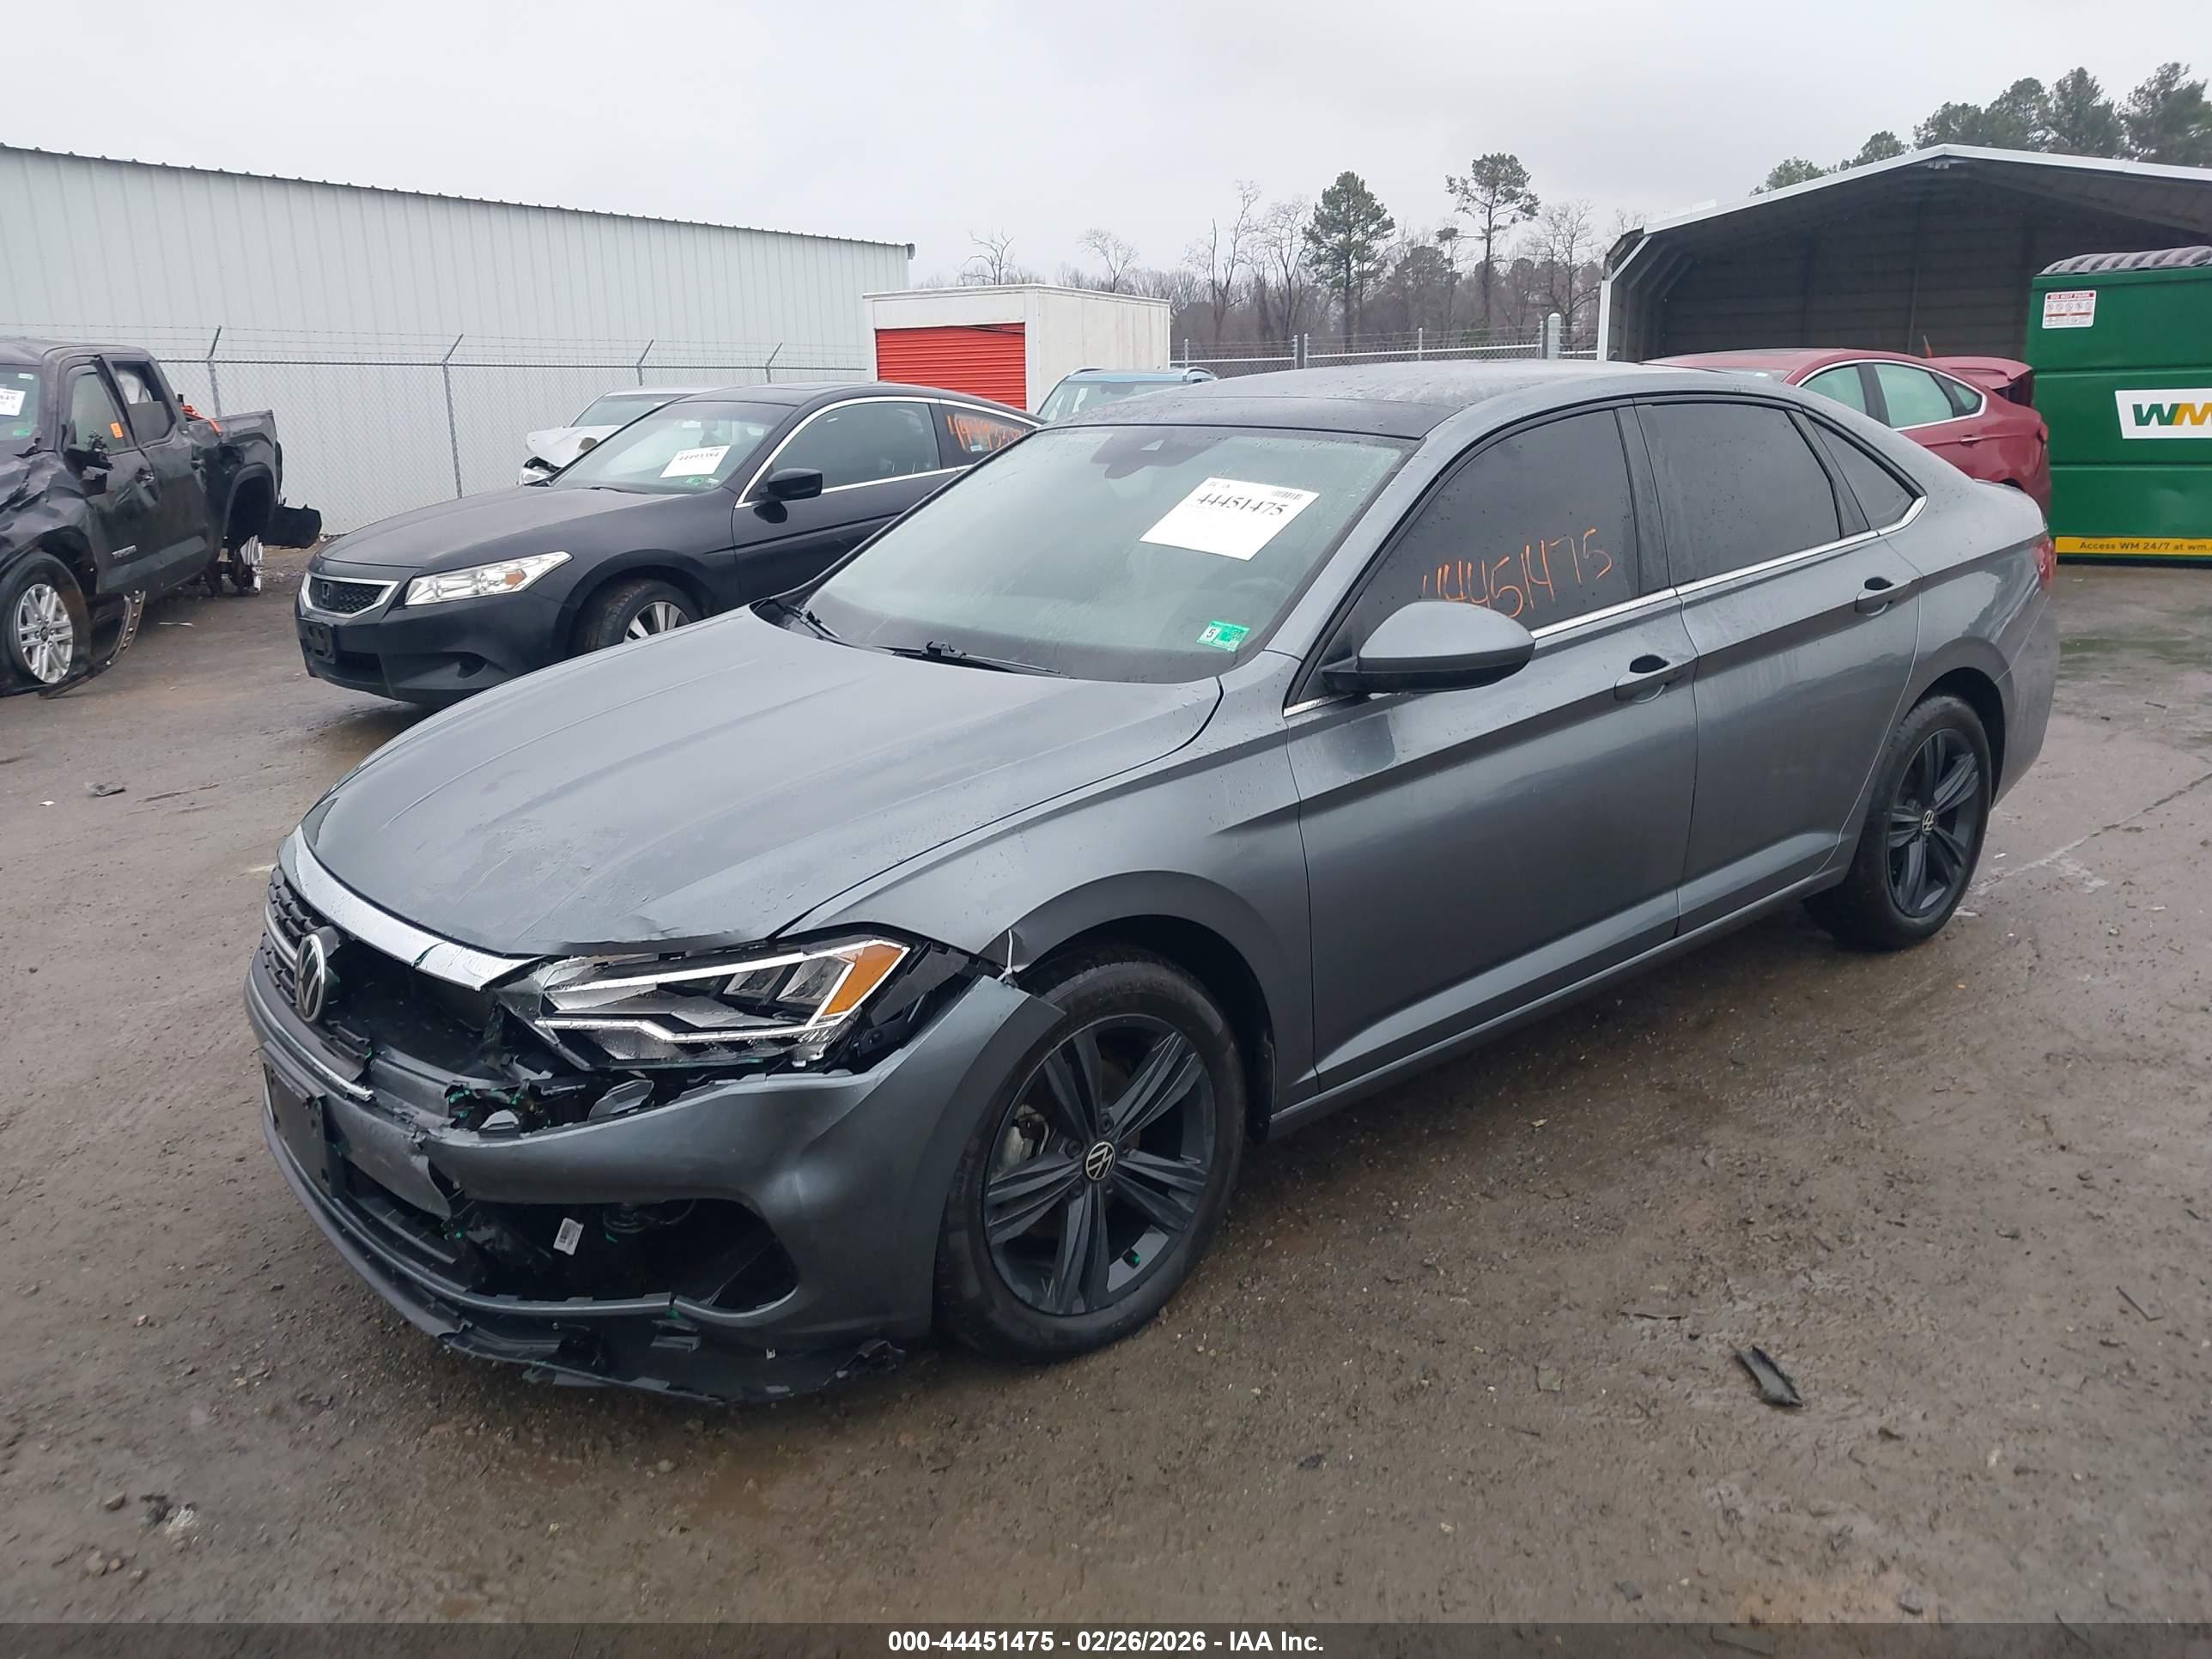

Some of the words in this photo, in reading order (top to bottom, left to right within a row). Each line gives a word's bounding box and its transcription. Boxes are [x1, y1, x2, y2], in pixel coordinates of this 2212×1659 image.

[2132, 403, 2212, 426] WM
[1197, 493, 1289, 515] 44451475
[2080, 542, 2116, 550] Access
[2119, 542, 2140, 550] WM
[2143, 542, 2171, 550] 24/7
[1206, 629, 1216, 638] 5
